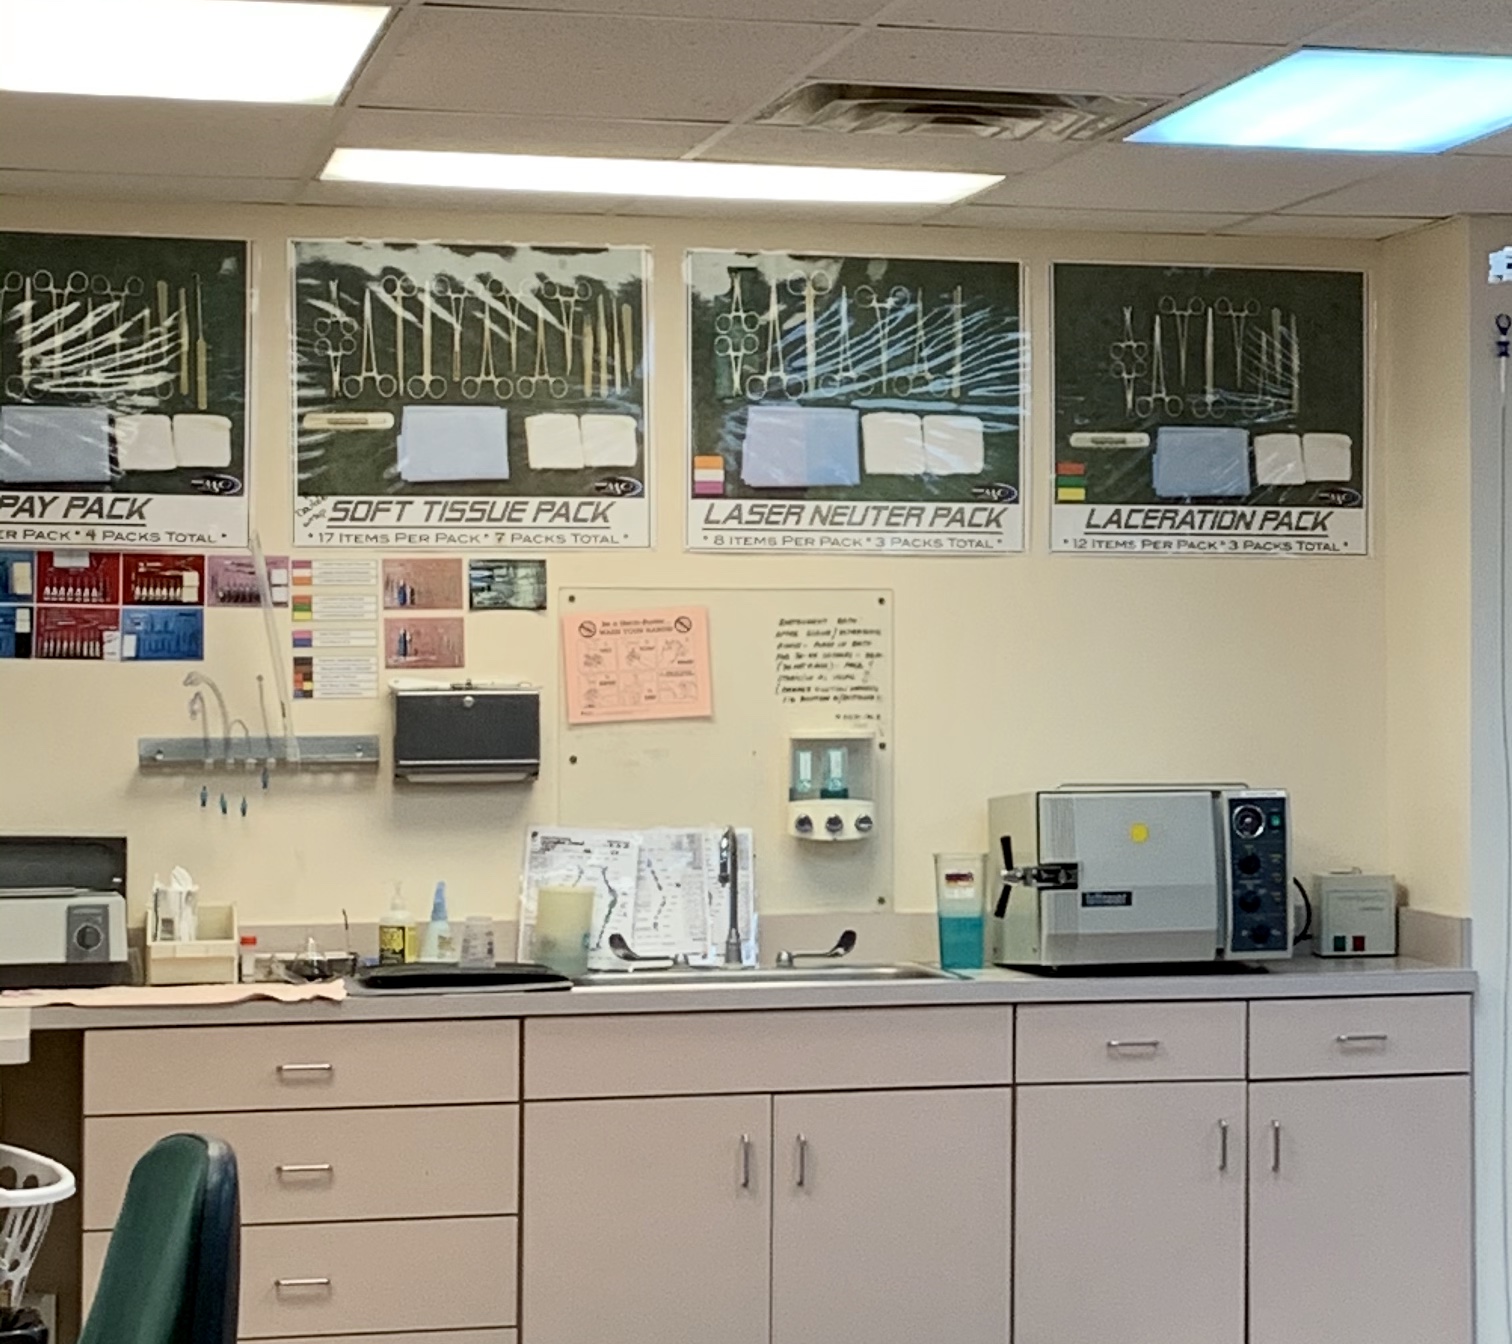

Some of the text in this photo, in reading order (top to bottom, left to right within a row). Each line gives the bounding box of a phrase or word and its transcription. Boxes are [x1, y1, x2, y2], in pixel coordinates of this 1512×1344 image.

[62, 497, 153, 520] PACK
[328, 500, 616, 524] SOFT TISSUE PACK
[703, 503, 1008, 529] LASER NEUTER PACK
[1085, 508, 1334, 532] LACERATION PACK
[22, 530, 71, 541] PACK
[85, 530, 96, 541] 4
[102, 530, 161, 542] PACKS
[165, 531, 217, 543] TOTAL
[318, 532, 620, 545] 17 ITEMS PER PACK 7 PACKS TOTAL
[713, 535, 994, 549] 8 ITEMS PER PACK 3 PACKS TOTAL
[1072, 538, 1341, 552] 12 ITEMS PER PACK 3 PACKS TOTAL
